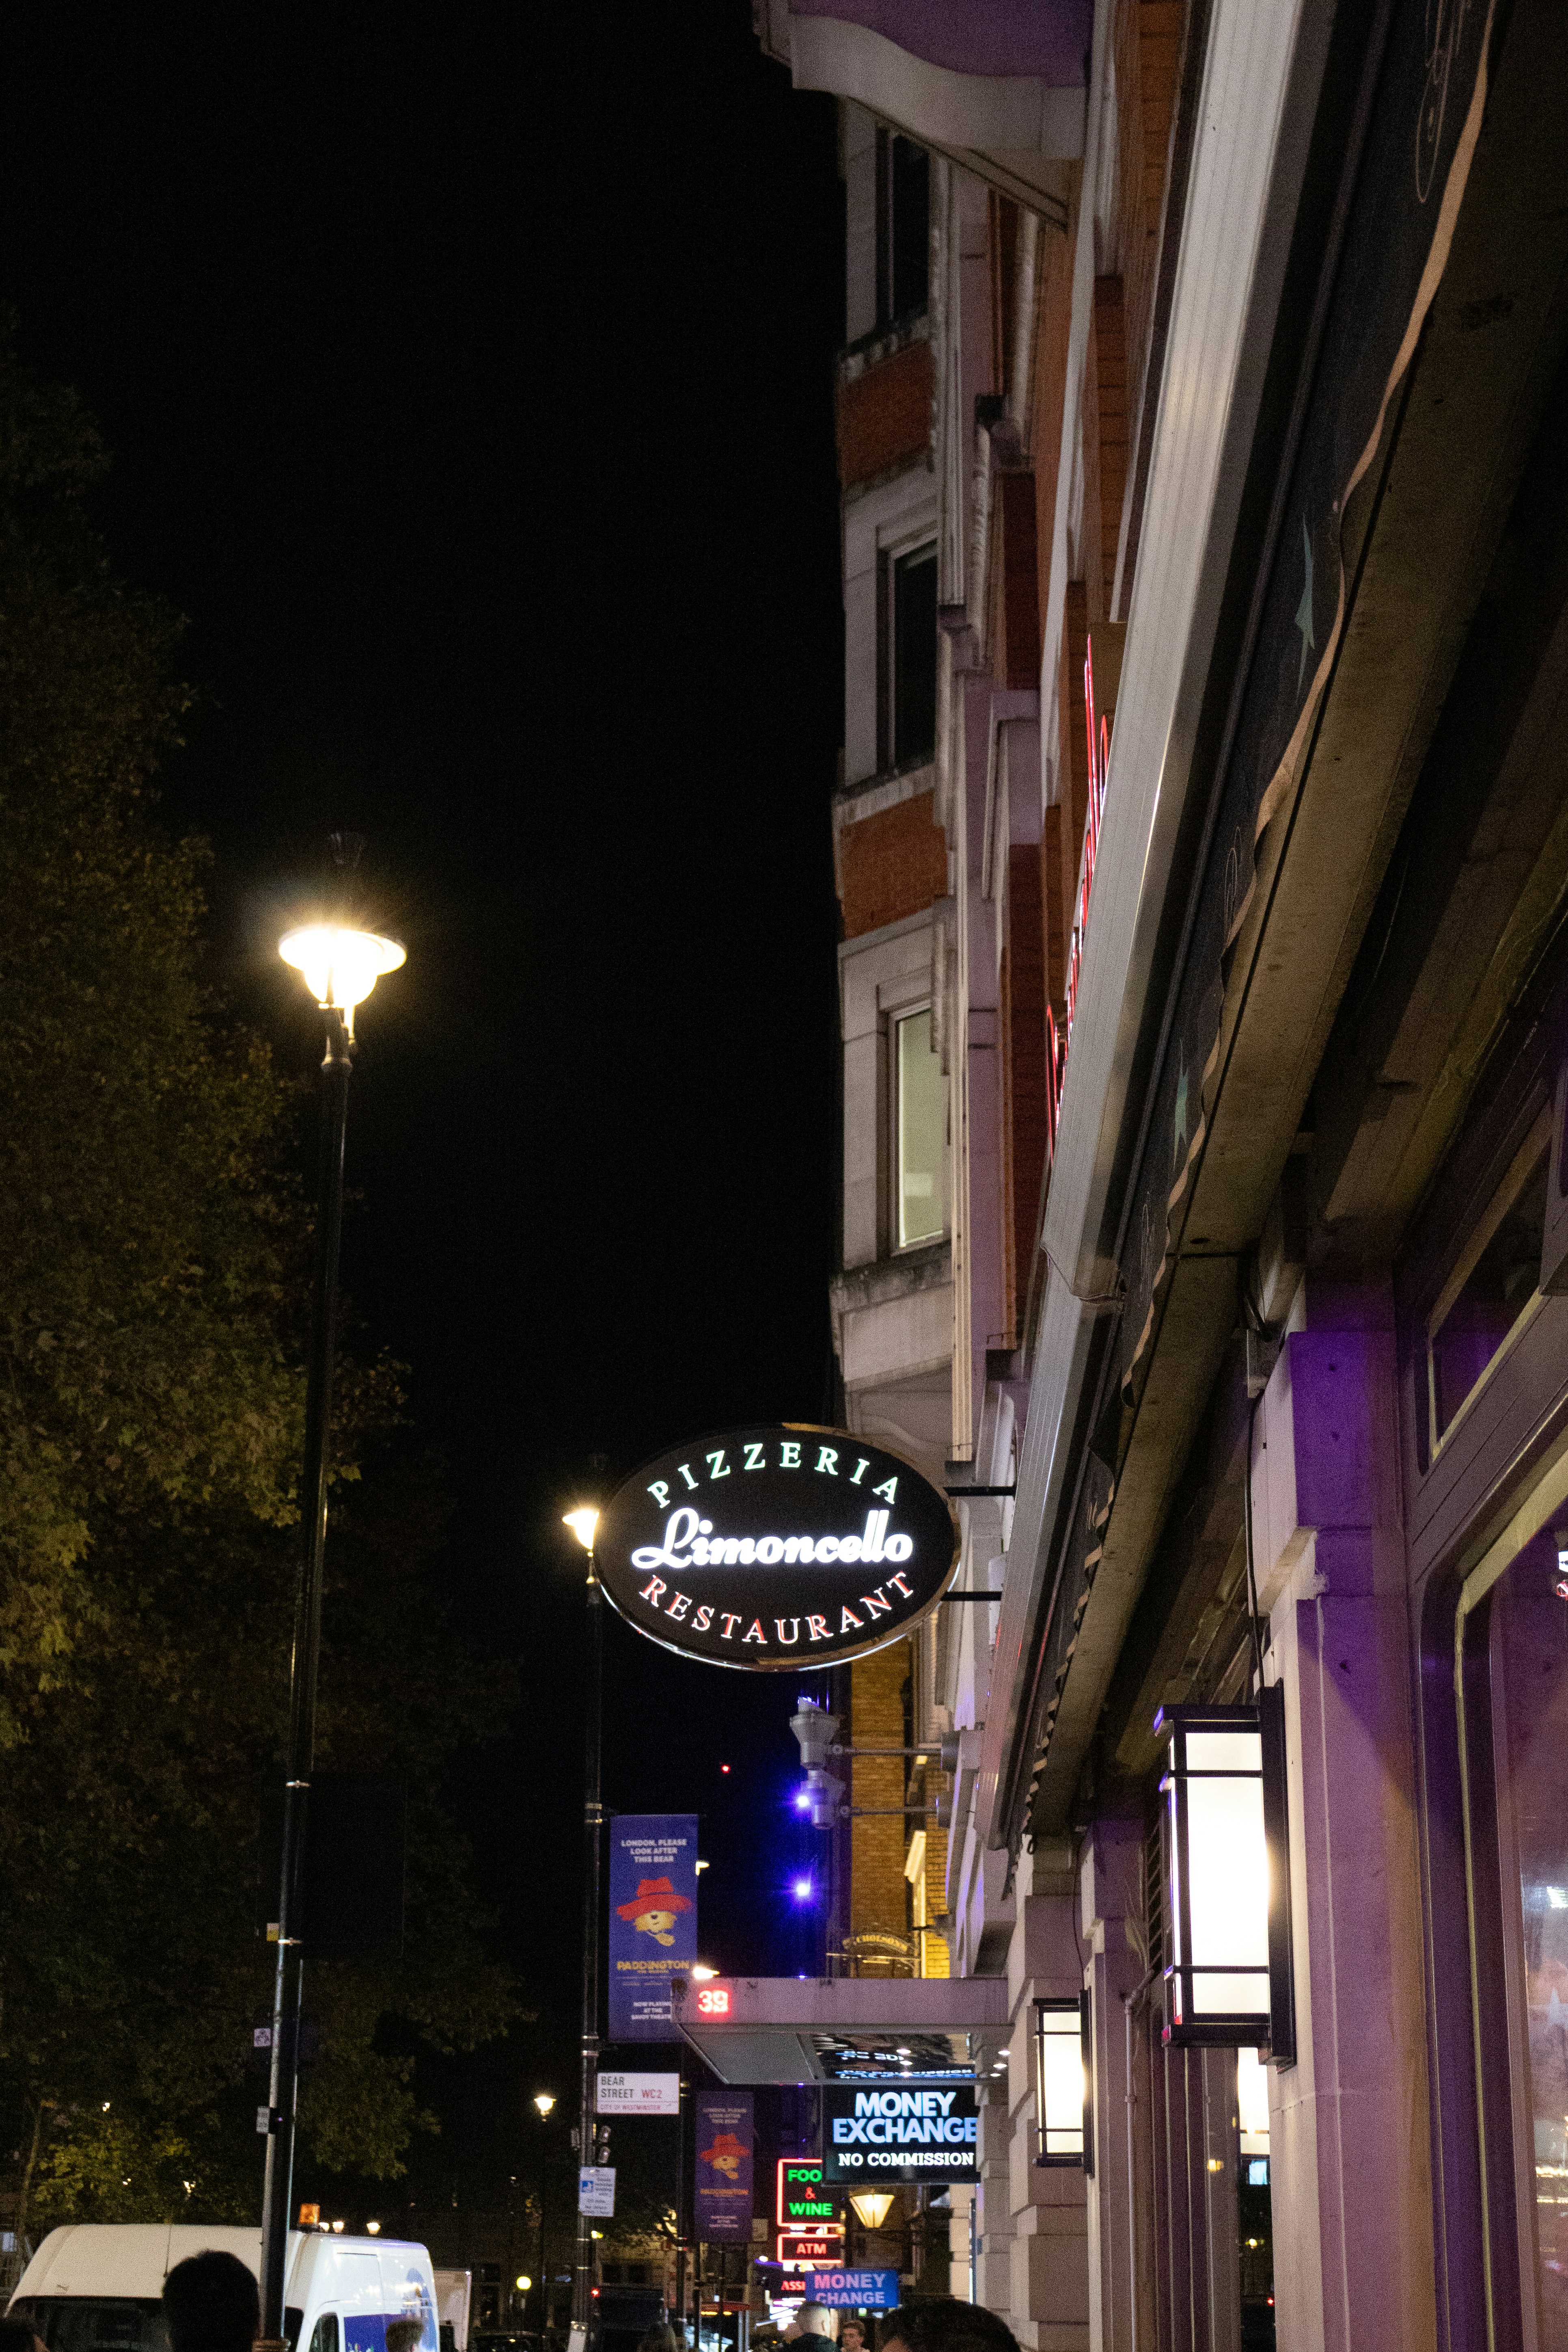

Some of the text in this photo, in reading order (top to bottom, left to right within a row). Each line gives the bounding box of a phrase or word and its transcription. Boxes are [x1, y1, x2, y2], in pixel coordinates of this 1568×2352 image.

[647, 1442, 898, 1508] PIZZERIA
[632, 1507, 913, 1569] Limoncello
[639, 1571, 913, 1644] RESTAURANT
[617, 1960, 690, 1970] PADDINGTON
[601, 2076, 624, 2085] BEAR
[601, 2089, 662, 2098] STREET WC2
[855, 2091, 956, 2117] MONEY
[833, 2117, 977, 2143] EXCHANGE
[838, 2153, 974, 2166] NO COMMISSION
[805, 2187, 815, 2199] &
[789, 2203, 833, 2216] WINE
[796, 2243, 827, 2254] ATM
[814, 2274, 885, 2288] MONEY
[815, 2291, 885, 2305] CHANGE
